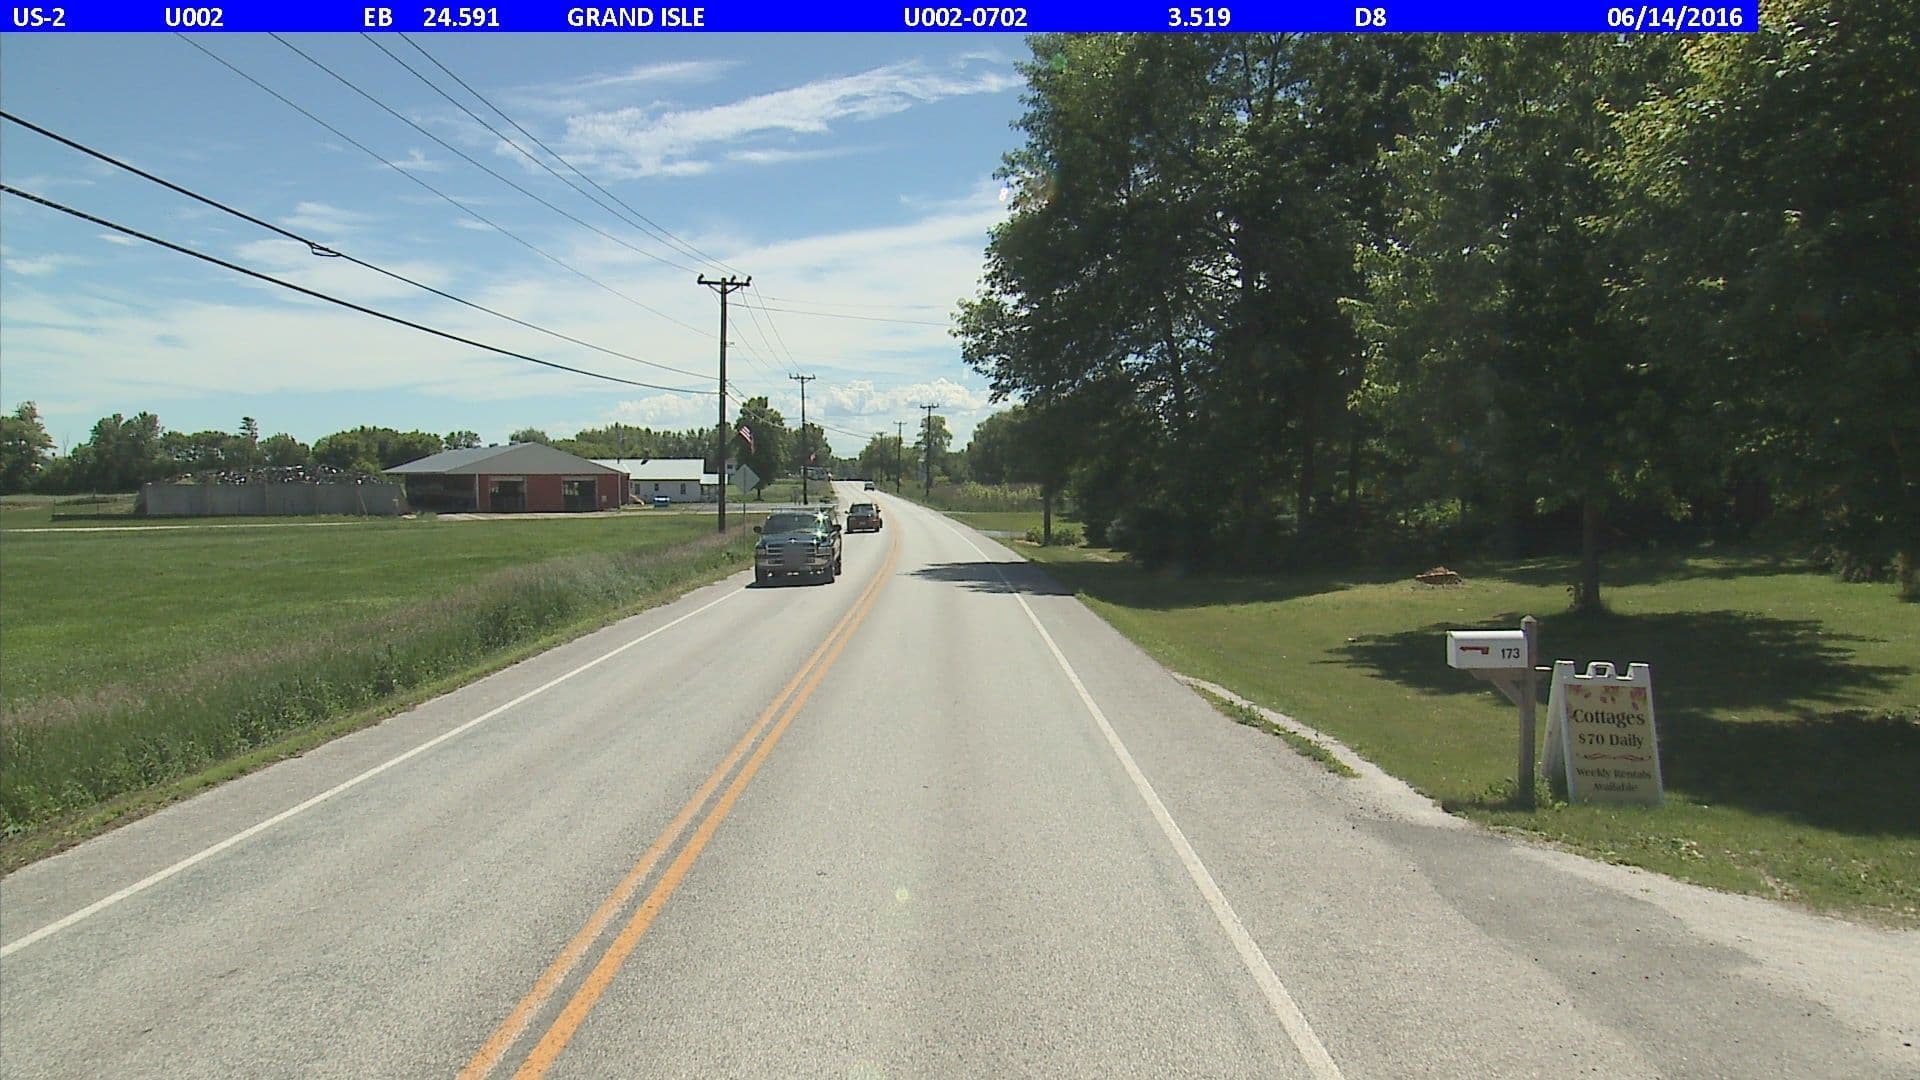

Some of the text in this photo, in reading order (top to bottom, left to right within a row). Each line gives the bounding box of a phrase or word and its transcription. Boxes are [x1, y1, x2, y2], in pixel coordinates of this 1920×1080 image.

[1500, 647, 1521, 660] 173
[1573, 708, 1646, 728] Cottages
[1578, 733, 1644, 749] $70 Daily
[1576, 767, 1611, 780] Weekly
